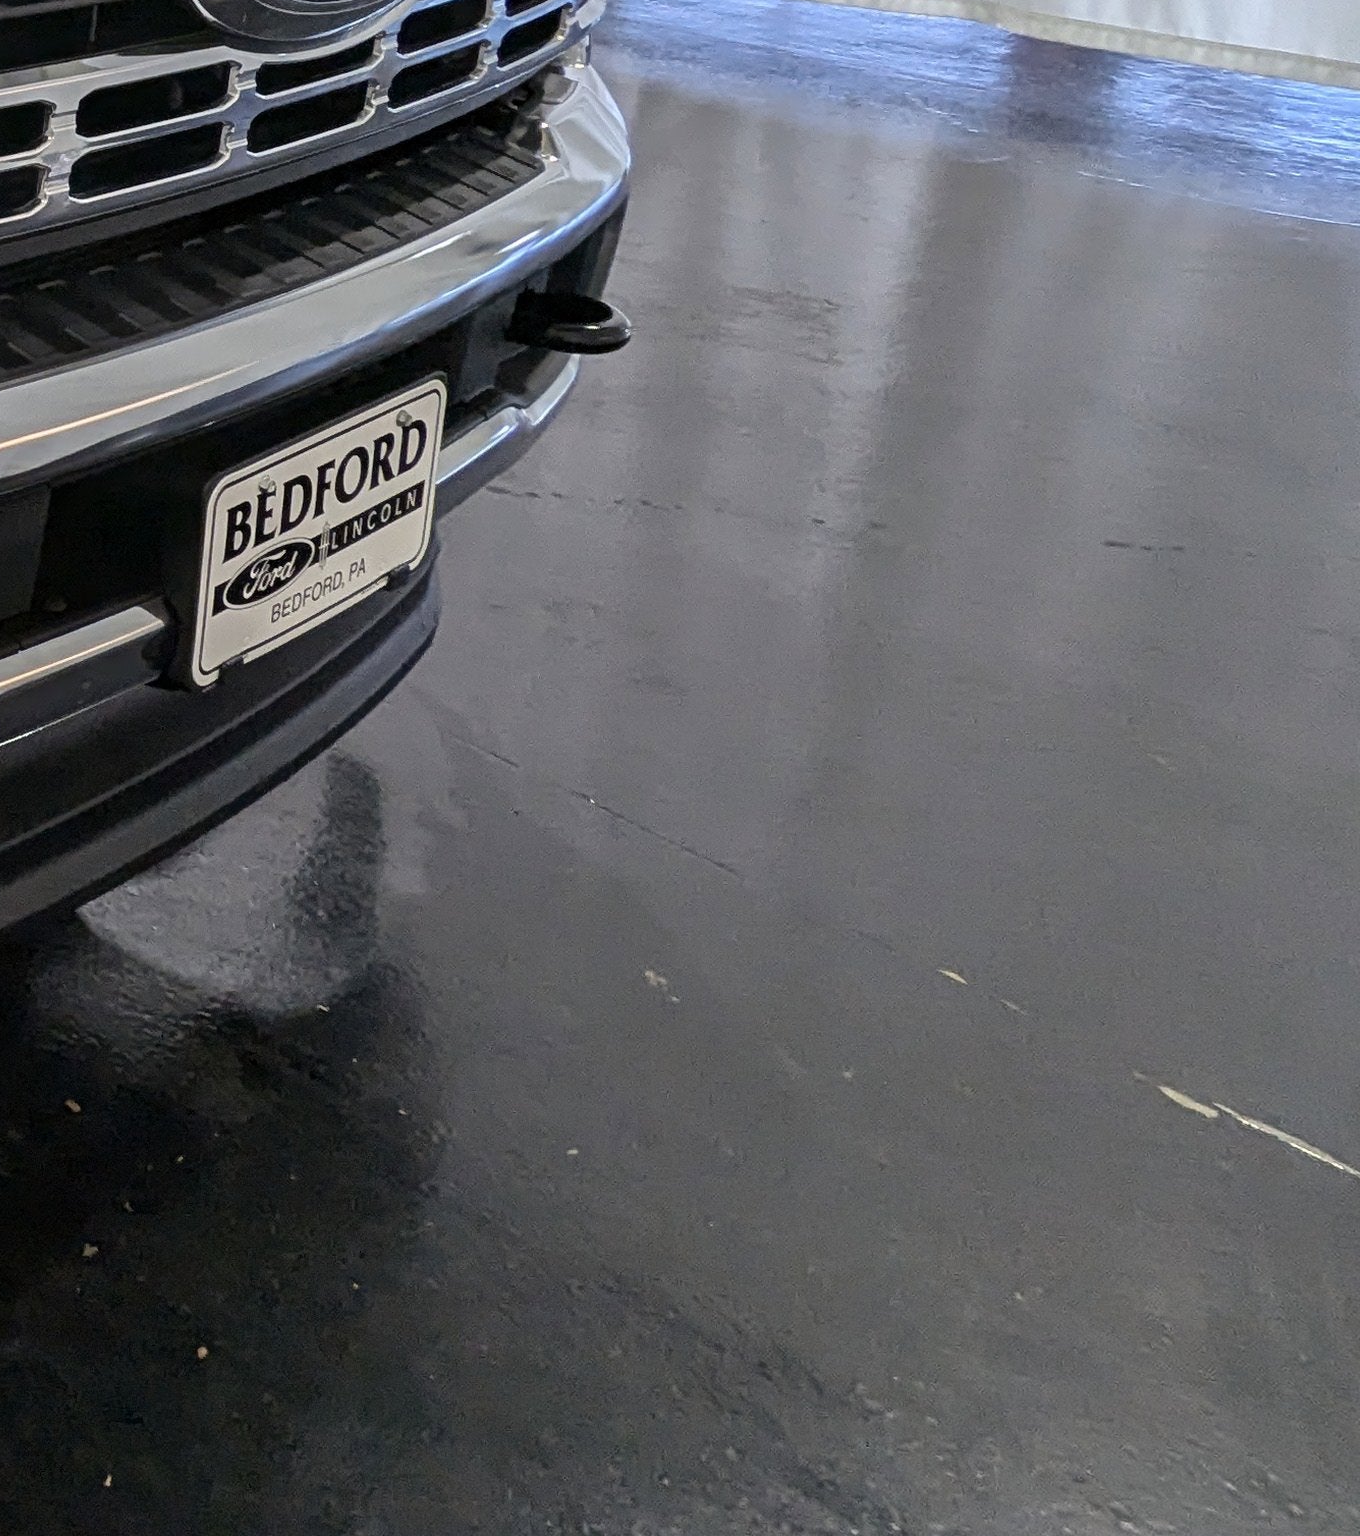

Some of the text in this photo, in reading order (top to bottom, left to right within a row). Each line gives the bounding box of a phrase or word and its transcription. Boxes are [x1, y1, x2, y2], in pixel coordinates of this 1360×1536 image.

[222, 419, 428, 565] BEDFORD
[330, 488, 419, 551] LINCOLN
[242, 548, 300, 600] Ford
[270, 557, 366, 624] BEDFORD, PA
